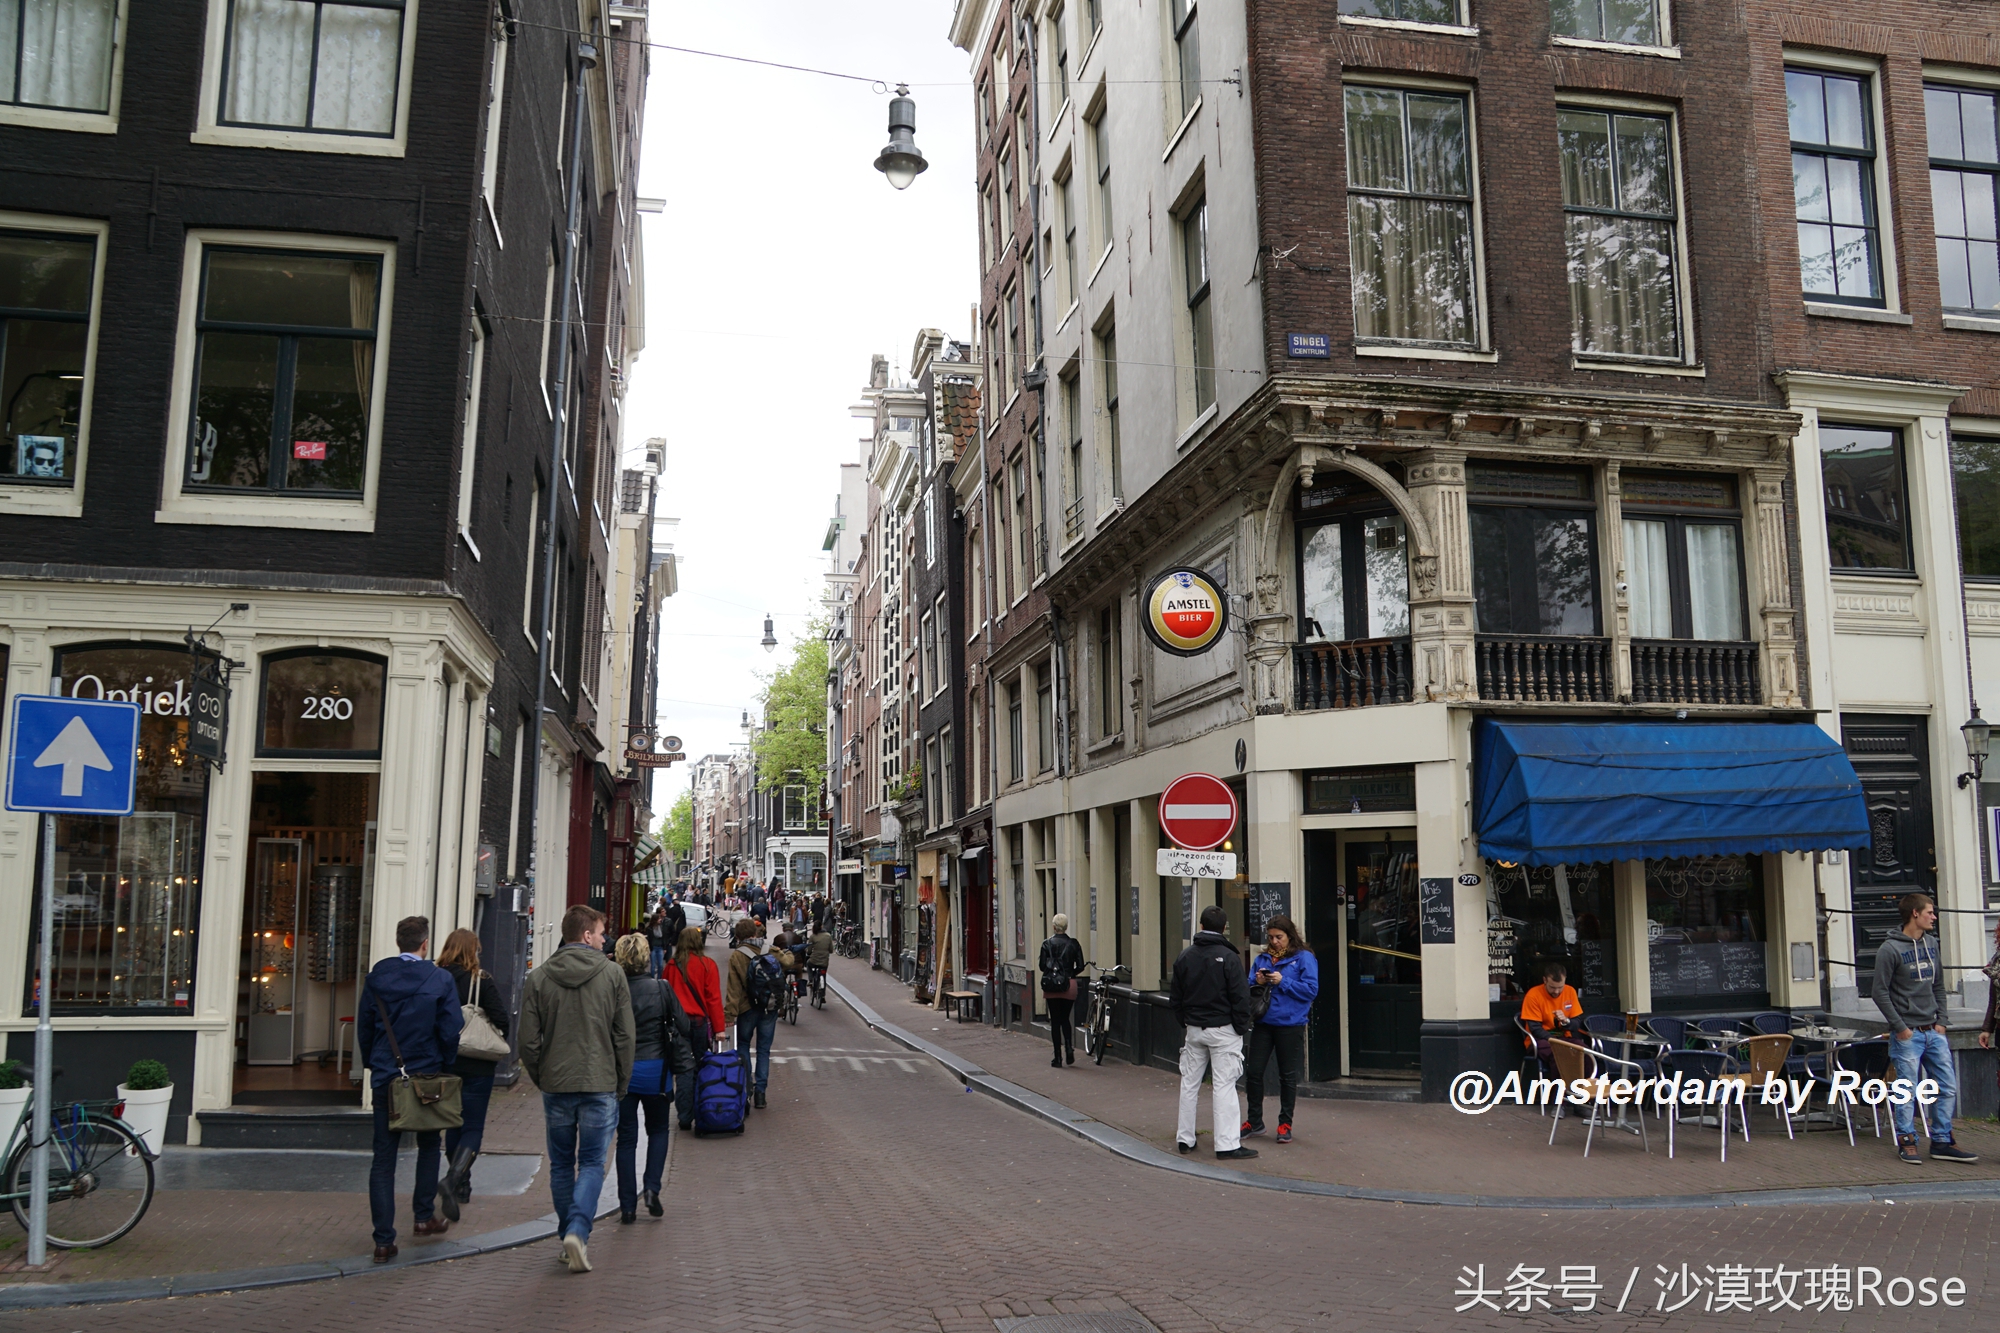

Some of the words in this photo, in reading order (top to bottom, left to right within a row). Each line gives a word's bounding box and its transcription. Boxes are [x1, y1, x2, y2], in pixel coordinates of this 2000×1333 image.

[1293, 336, 1326, 347] SINGEL
[1292, 348, 1327, 356] (CENTRUM)
[1167, 599, 1211, 610] AMSTEL
[1179, 613, 1202, 622] BIER
[300, 696, 354, 720] 280
[624, 750, 685, 762] BRILMUSEUM
[1461, 875, 1478, 885] 278
[1420, 879, 1441, 895] This
[1260, 900, 1284, 911] Coffee
[1421, 896, 1451, 918] Tuesday
[1432, 924, 1453, 936] Jazz
